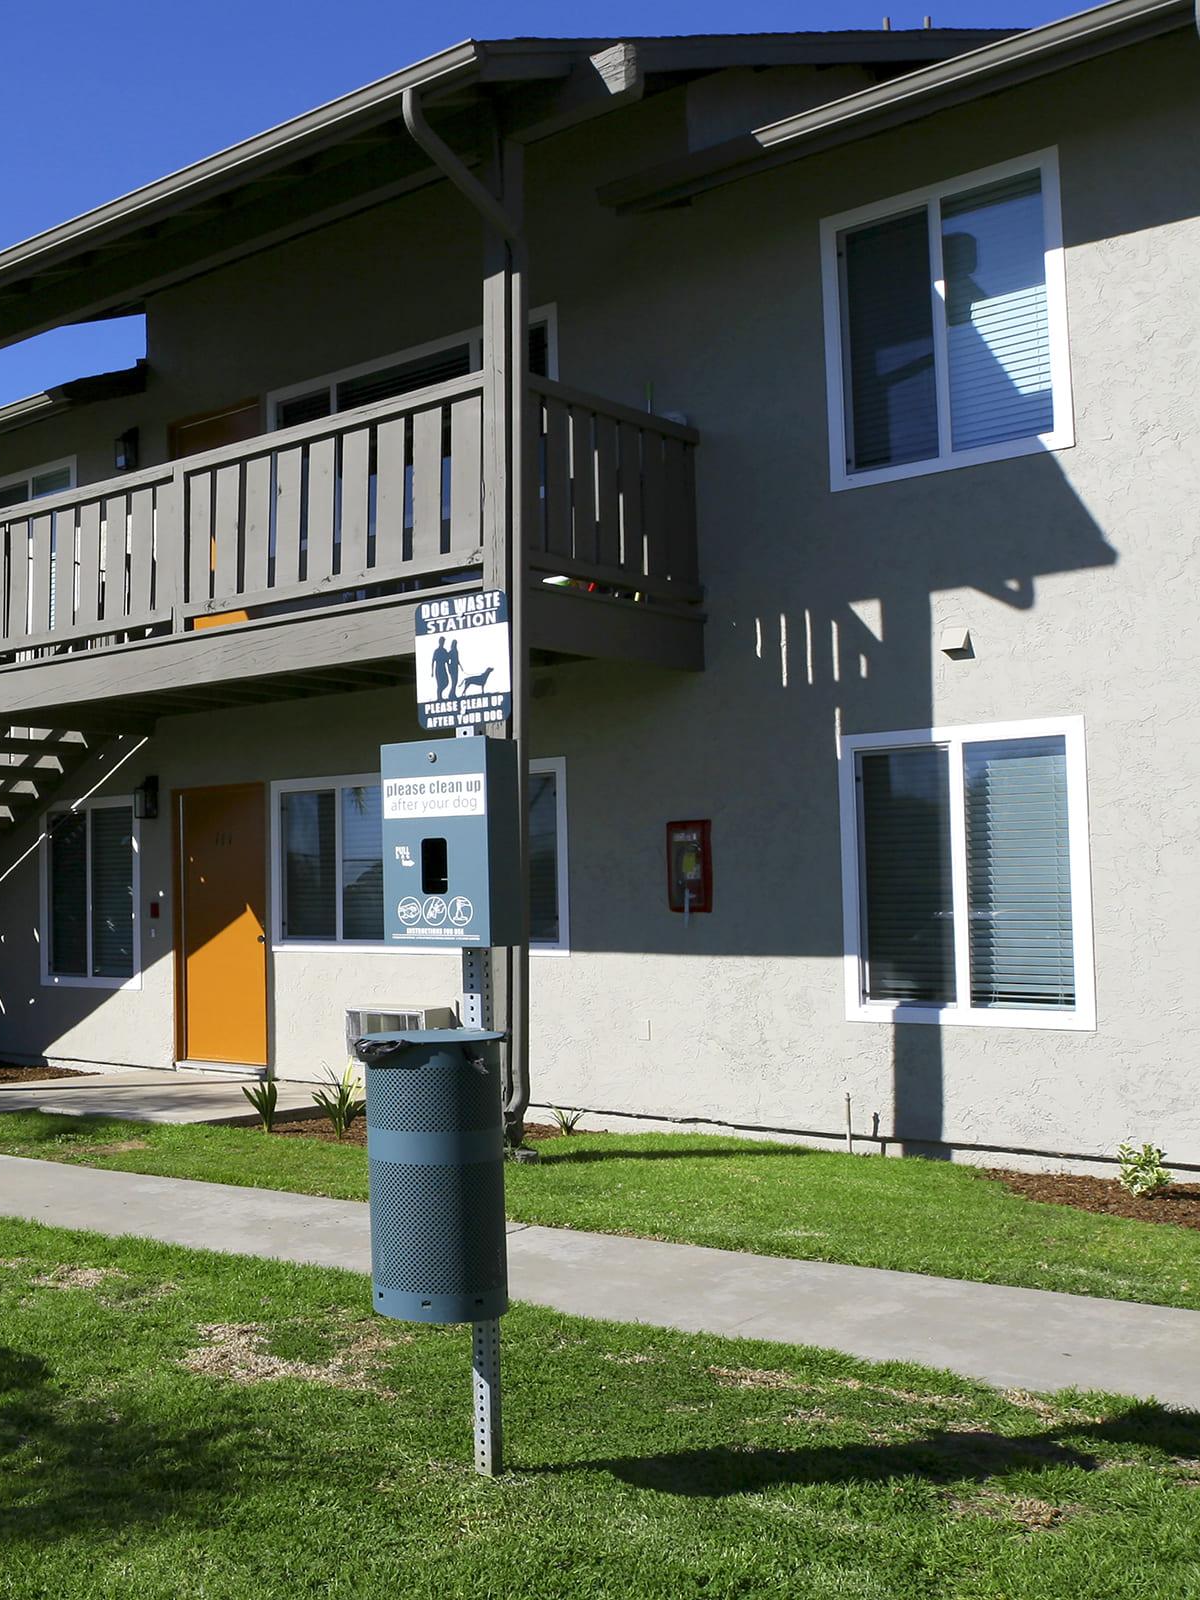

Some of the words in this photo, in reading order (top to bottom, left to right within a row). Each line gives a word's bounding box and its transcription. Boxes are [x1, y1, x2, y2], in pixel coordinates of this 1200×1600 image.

[421, 601, 450, 619] DOG
[453, 591, 500, 614] WASTE
[426, 610, 497, 634] STATION
[424, 701, 458, 715] PLEASE
[460, 696, 489, 710] CLEAN
[491, 695, 504, 707] UP
[426, 715, 455, 728] AFTER
[457, 712, 481, 725] YOUR
[483, 709, 503, 722] DOG
[386, 783, 426, 798] please
[429, 780, 463, 794] clean
[466, 779, 481, 793] up
[390, 798, 419, 812] after
[422, 799, 450, 813] your
[452, 796, 478, 811] dog
